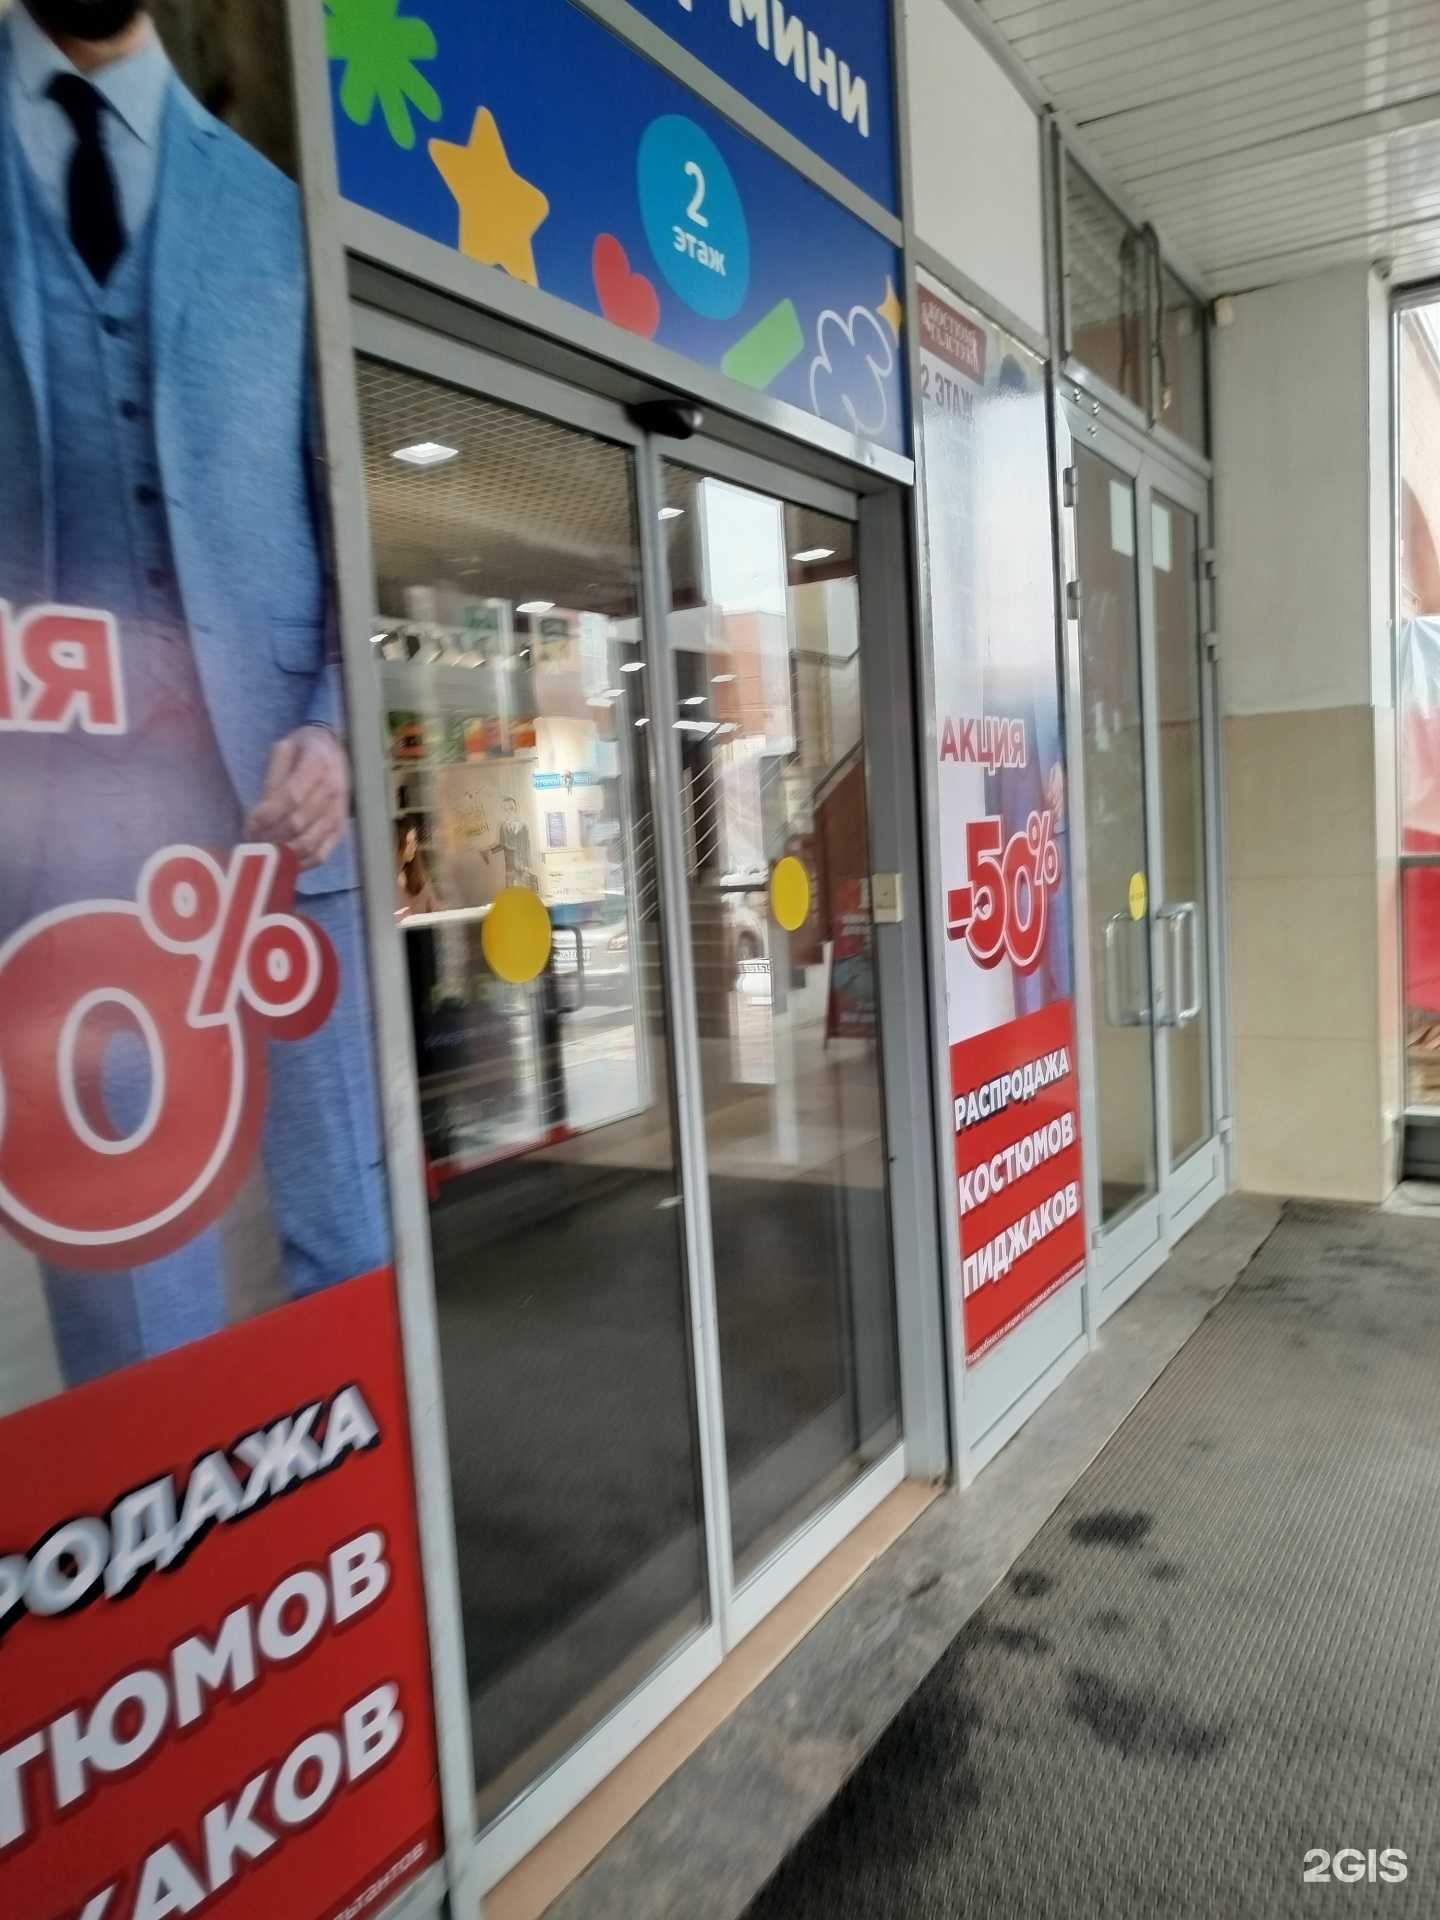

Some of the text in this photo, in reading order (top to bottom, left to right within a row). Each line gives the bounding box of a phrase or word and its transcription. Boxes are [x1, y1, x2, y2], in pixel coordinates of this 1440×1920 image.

[728, 0, 870, 139] МИНИ
[685, 160, 709, 228] 2
[672, 226, 727, 276] этаж
[920, 363, 931, 400] 2
[939, 715, 1026, 775] АКЦИЯ
[946, 810, 1061, 973] -50%
[954, 1047, 1070, 1132] РАСПРОДАЖА
[959, 1111, 1074, 1216] КОСТЮМОВ
[962, 1182, 1080, 1299] ПИДЖАКОВ
[80, 1681, 403, 1920] АКОВ
